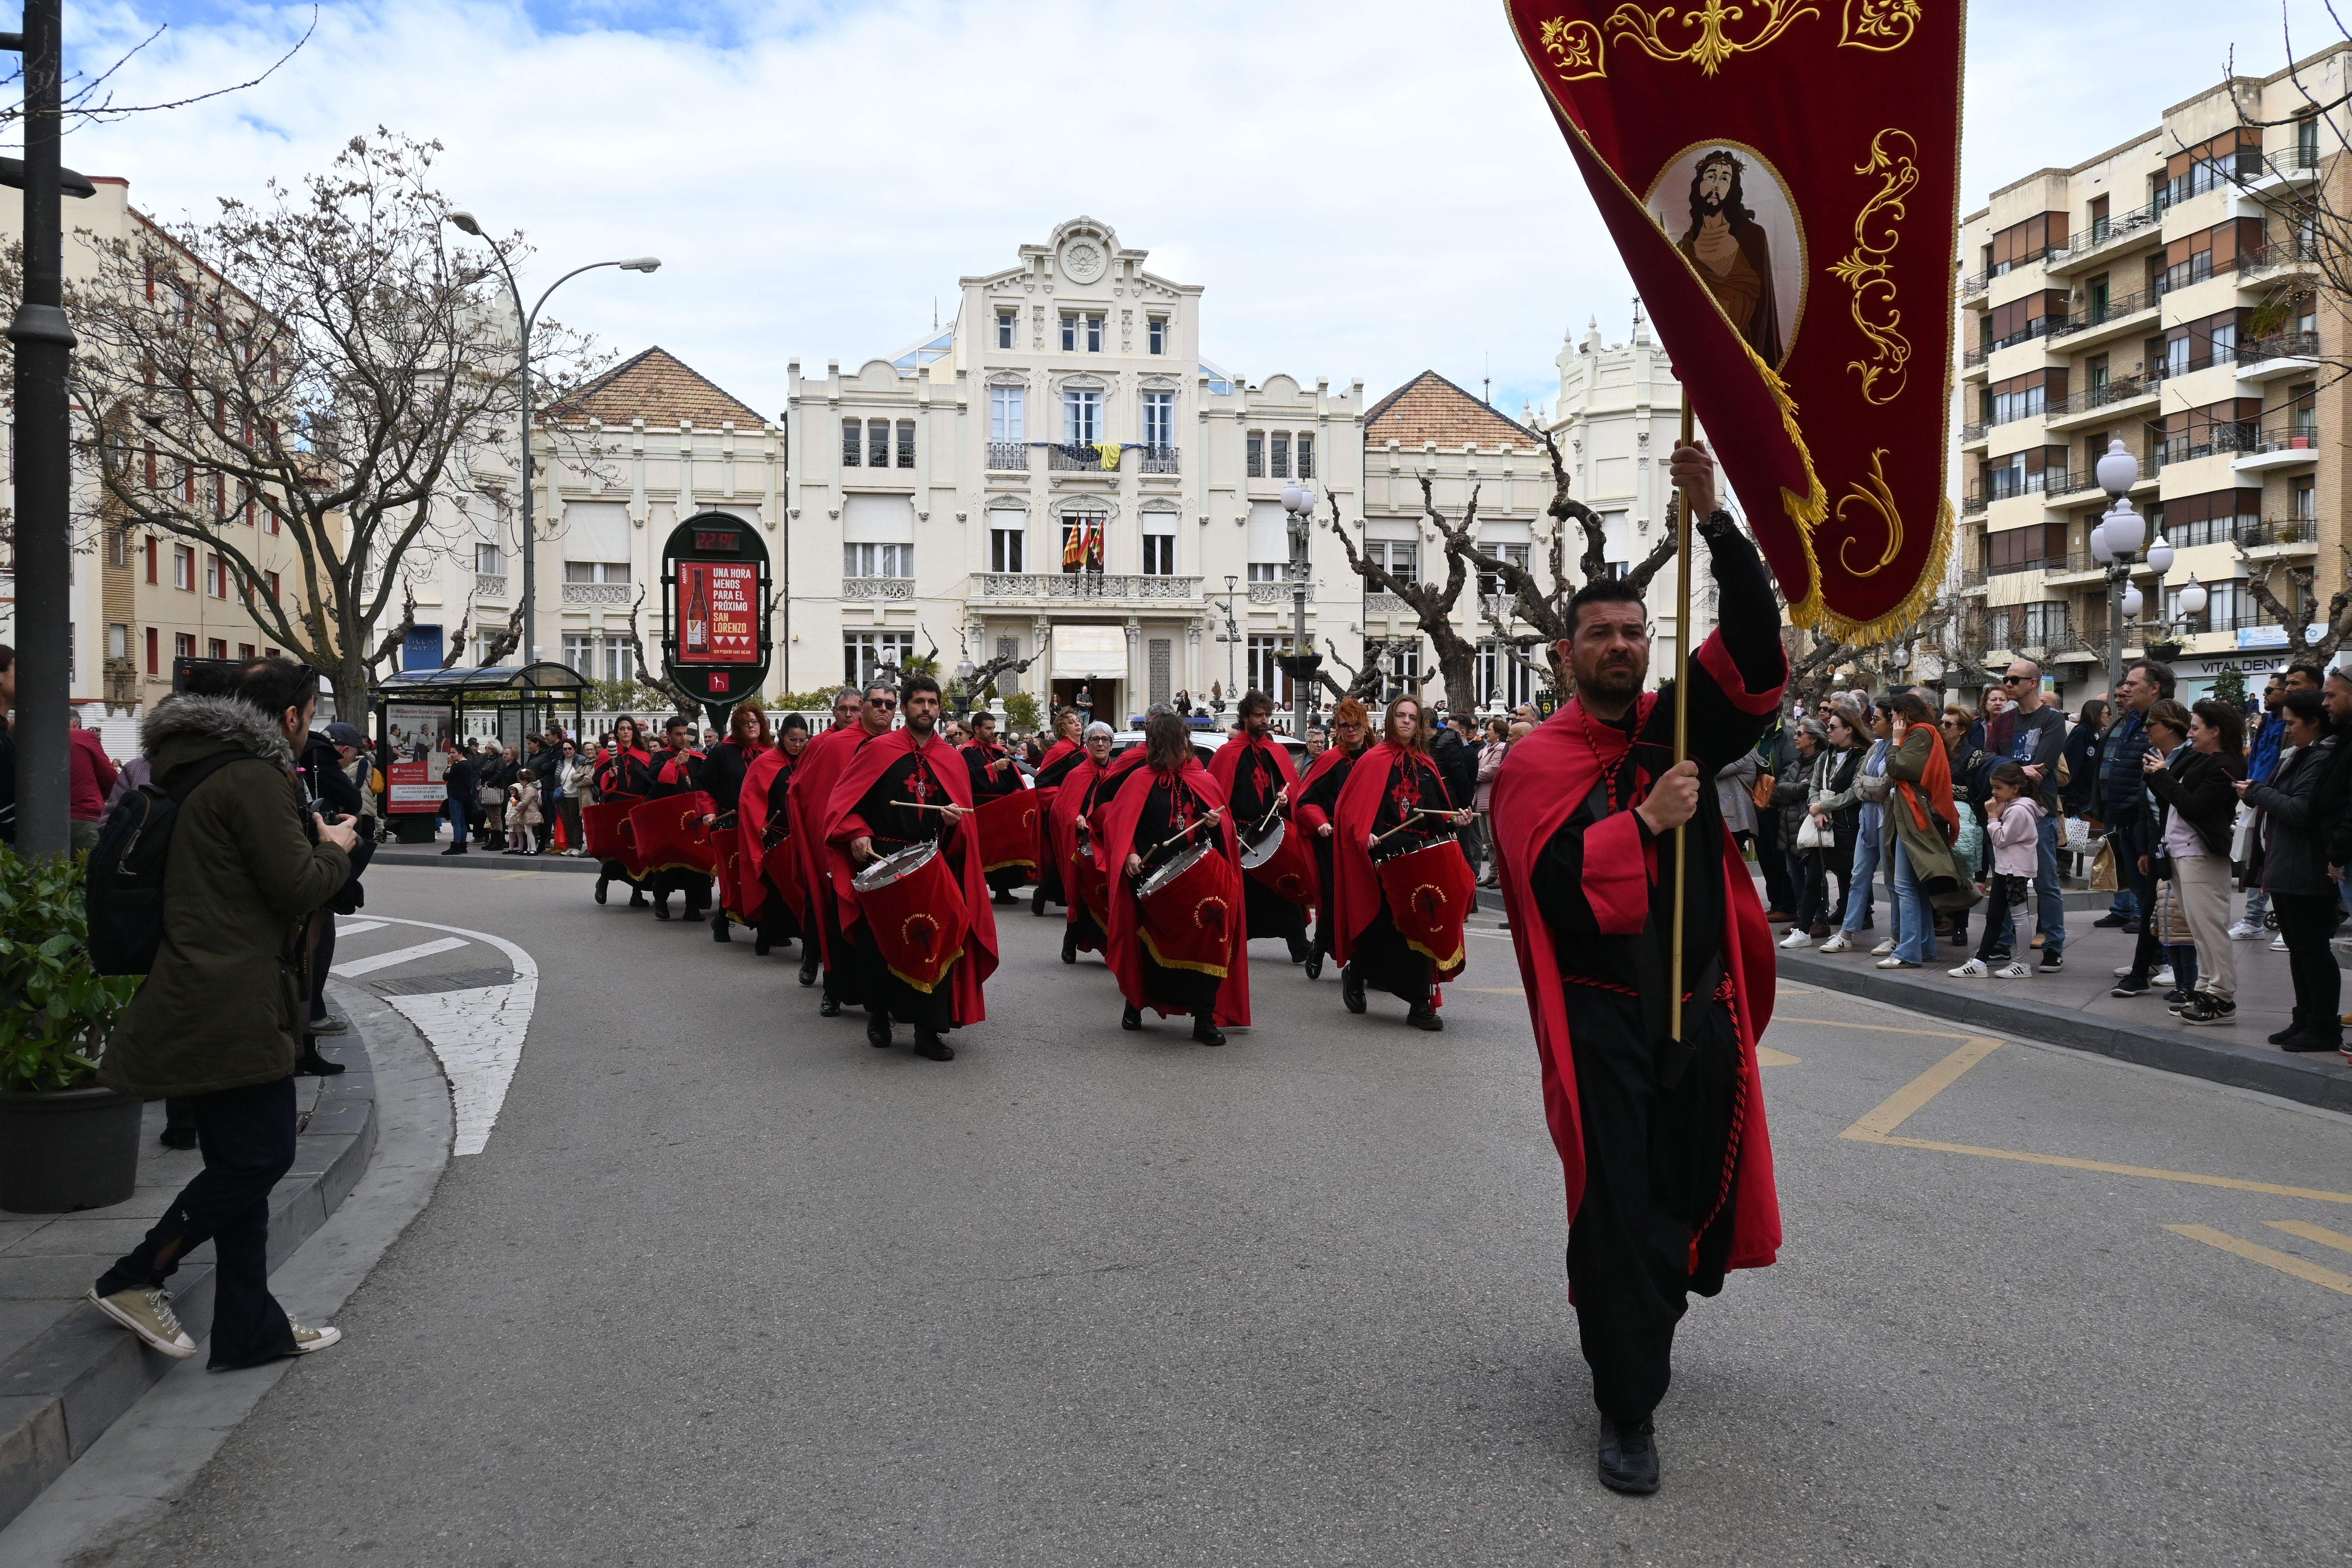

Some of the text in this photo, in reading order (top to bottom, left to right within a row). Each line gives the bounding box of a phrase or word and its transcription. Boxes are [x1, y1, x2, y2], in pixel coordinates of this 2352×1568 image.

[713, 568, 751, 578] UNA HORA
[713, 579, 740, 589] MENOS
[713, 590, 744, 600] PARA EL
[713, 600, 748, 611] PRÓXIMO
[713, 612, 729, 622] SAN
[713, 623, 746, 634] LORENZO
[2201, 658, 2285, 672] VITALDENT
[1960, 675, 1968, 684] LA
